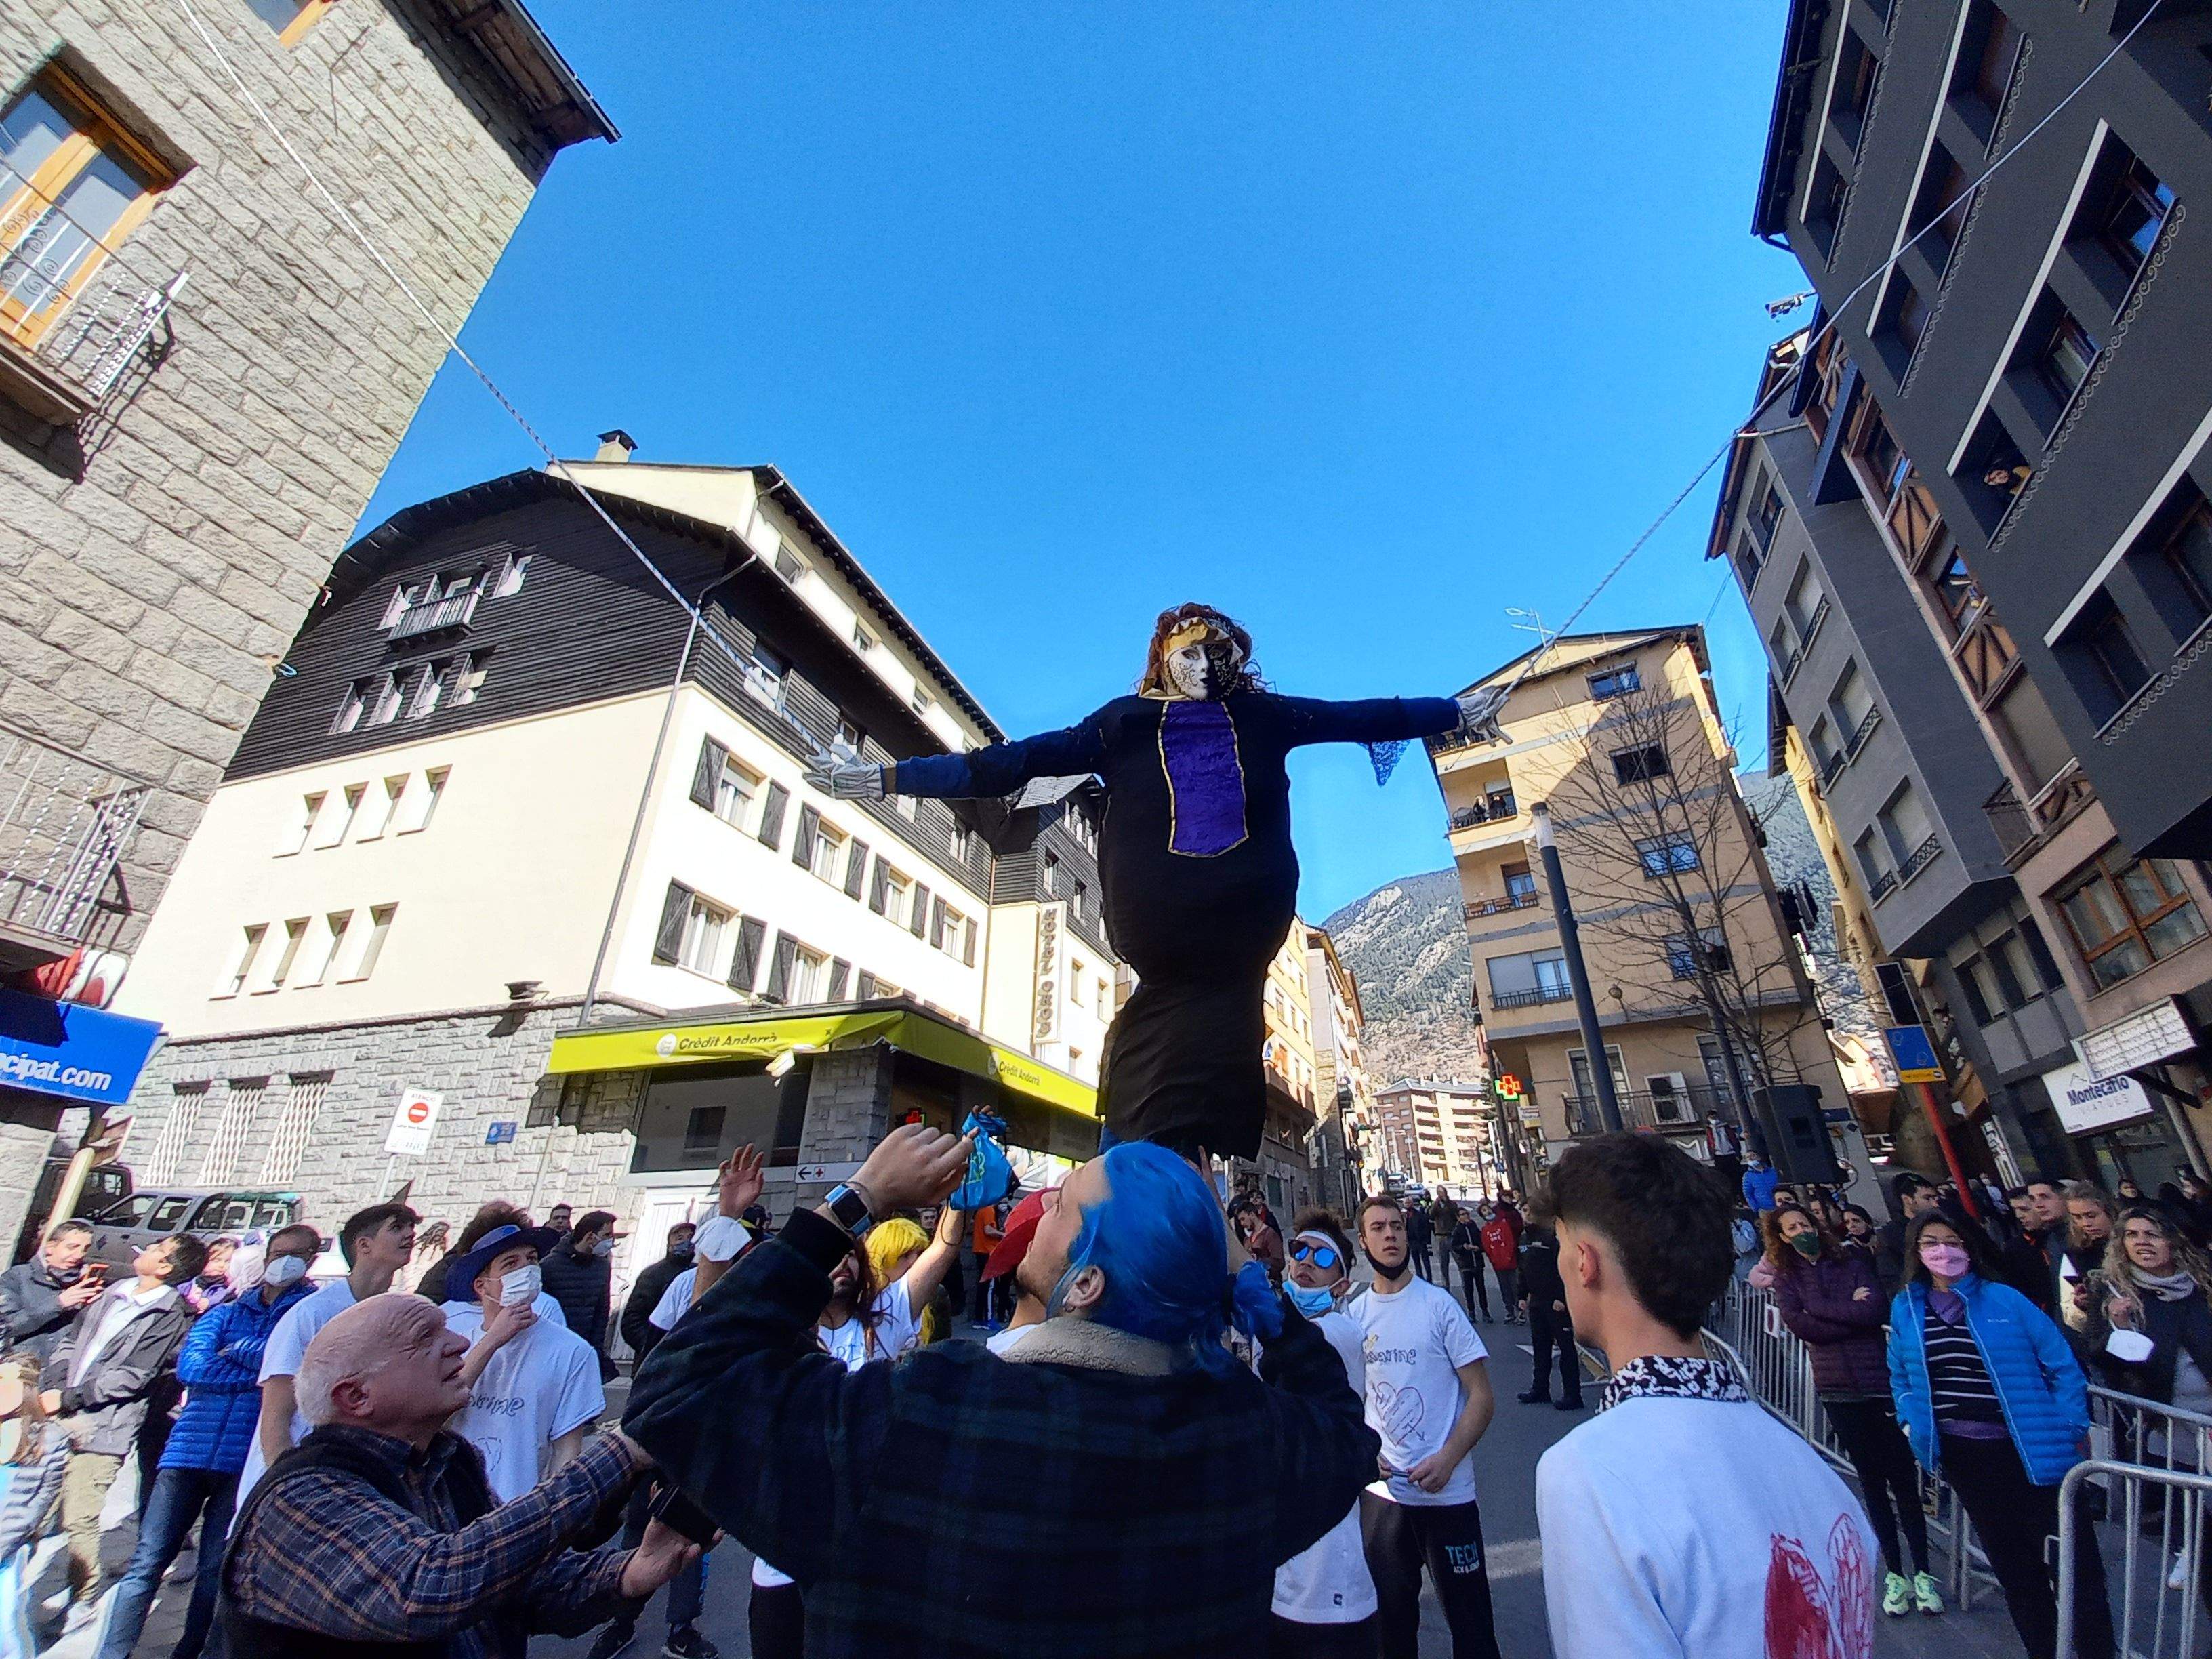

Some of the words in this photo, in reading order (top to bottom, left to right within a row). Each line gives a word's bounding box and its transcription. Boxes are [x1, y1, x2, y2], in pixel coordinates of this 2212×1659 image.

[1042, 909, 1057, 975] HOTEL
[679, 1036, 720, 1050] Crèdit
[2067, 1076, 2129, 1106] Montecarlo
